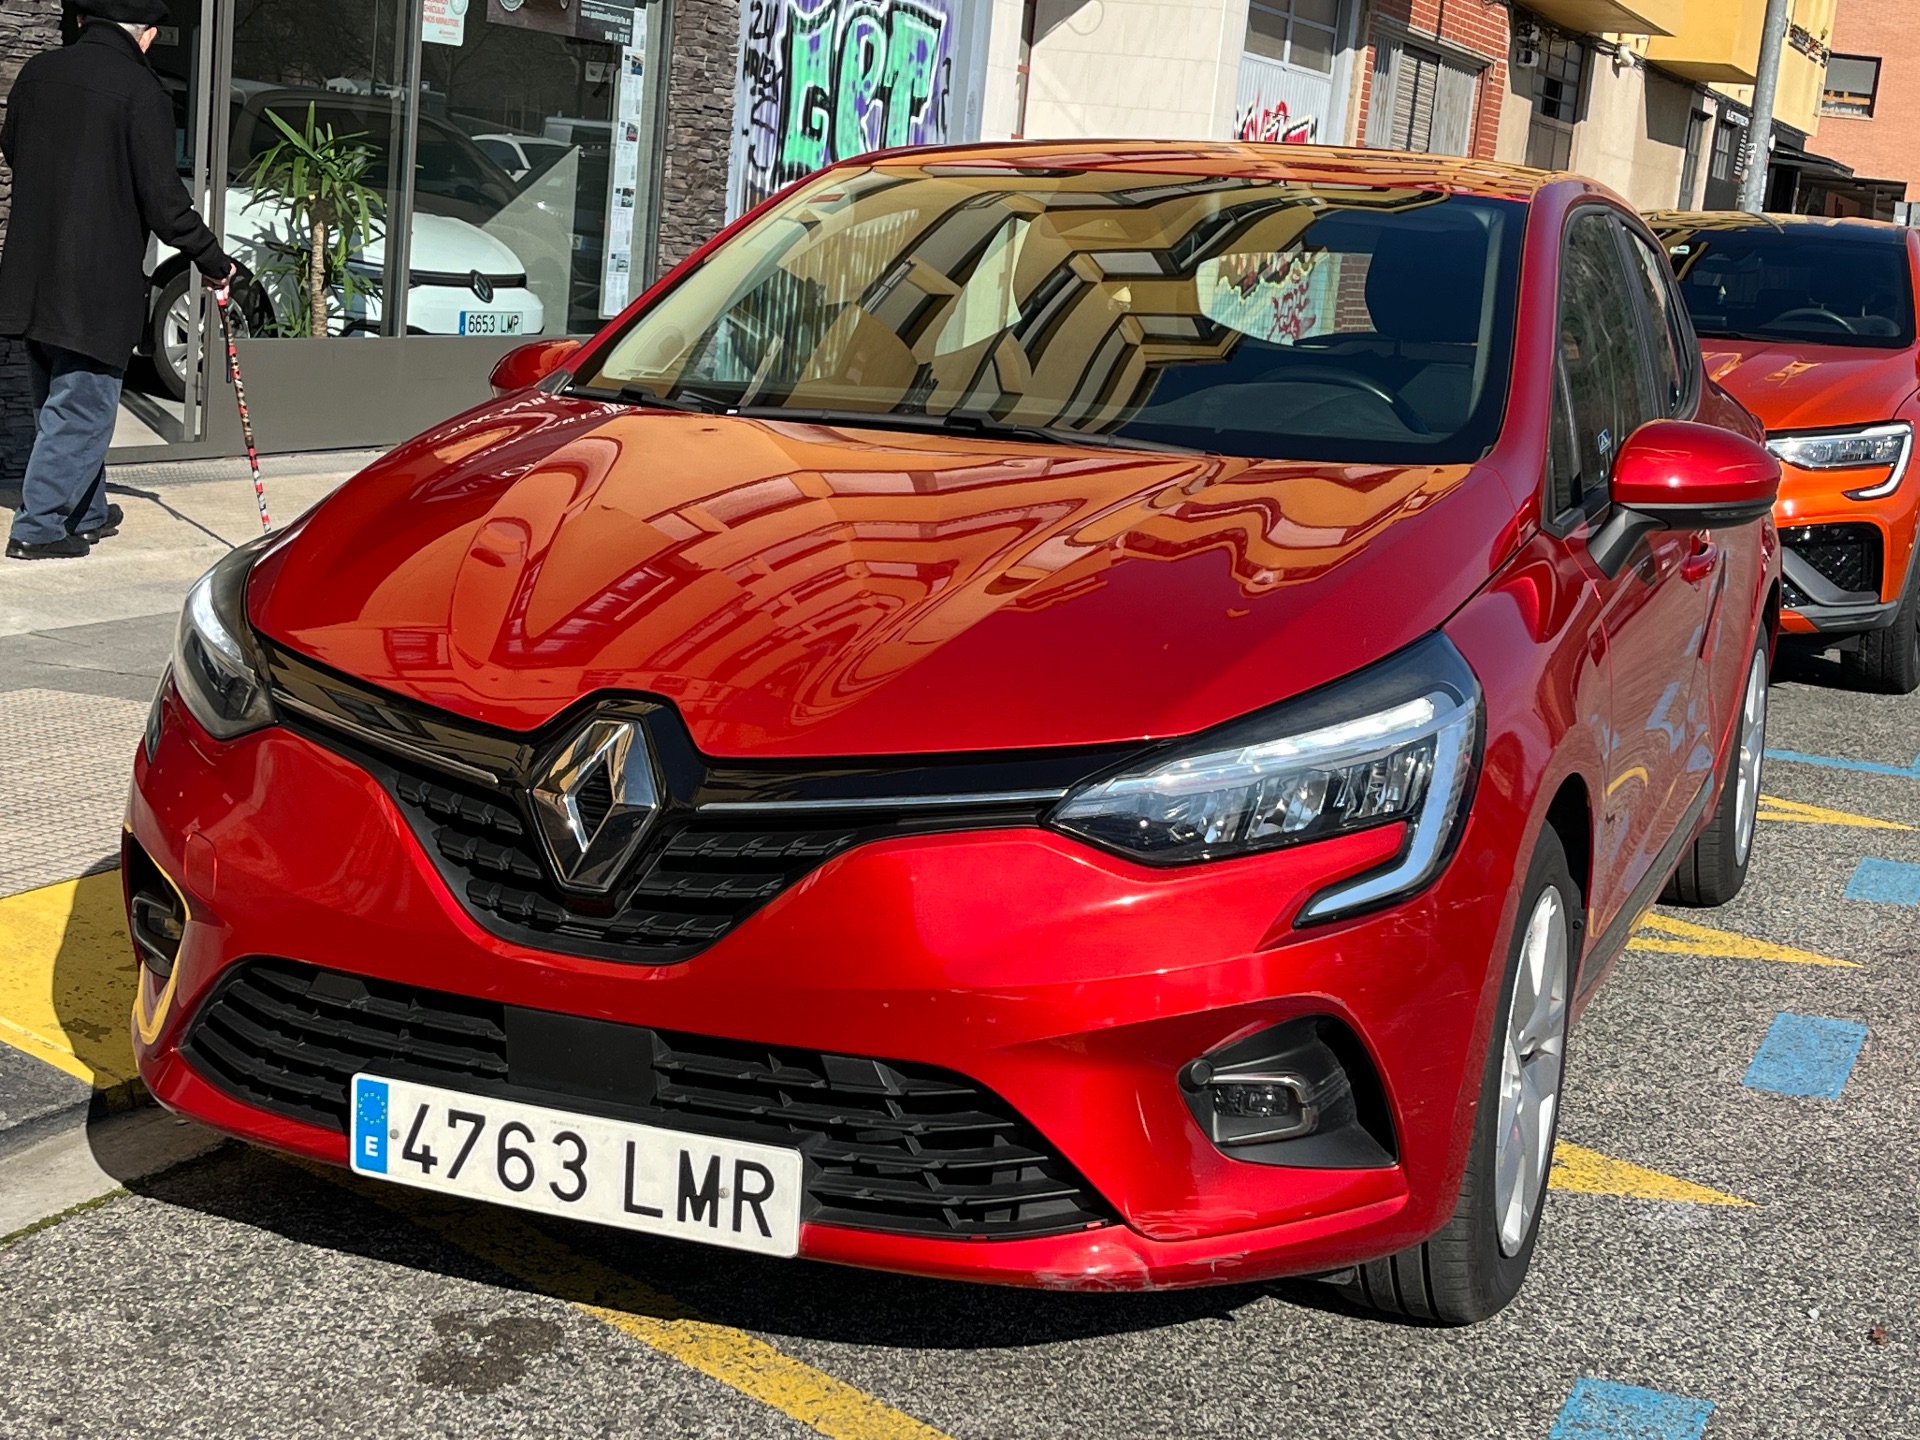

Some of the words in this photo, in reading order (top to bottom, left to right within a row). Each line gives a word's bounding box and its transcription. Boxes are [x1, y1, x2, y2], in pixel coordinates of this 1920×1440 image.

[468, 314, 496, 333] 6653
[364, 1135, 379, 1157] E
[402, 1103, 588, 1203] 4763
[623, 1140, 775, 1238] LMR
